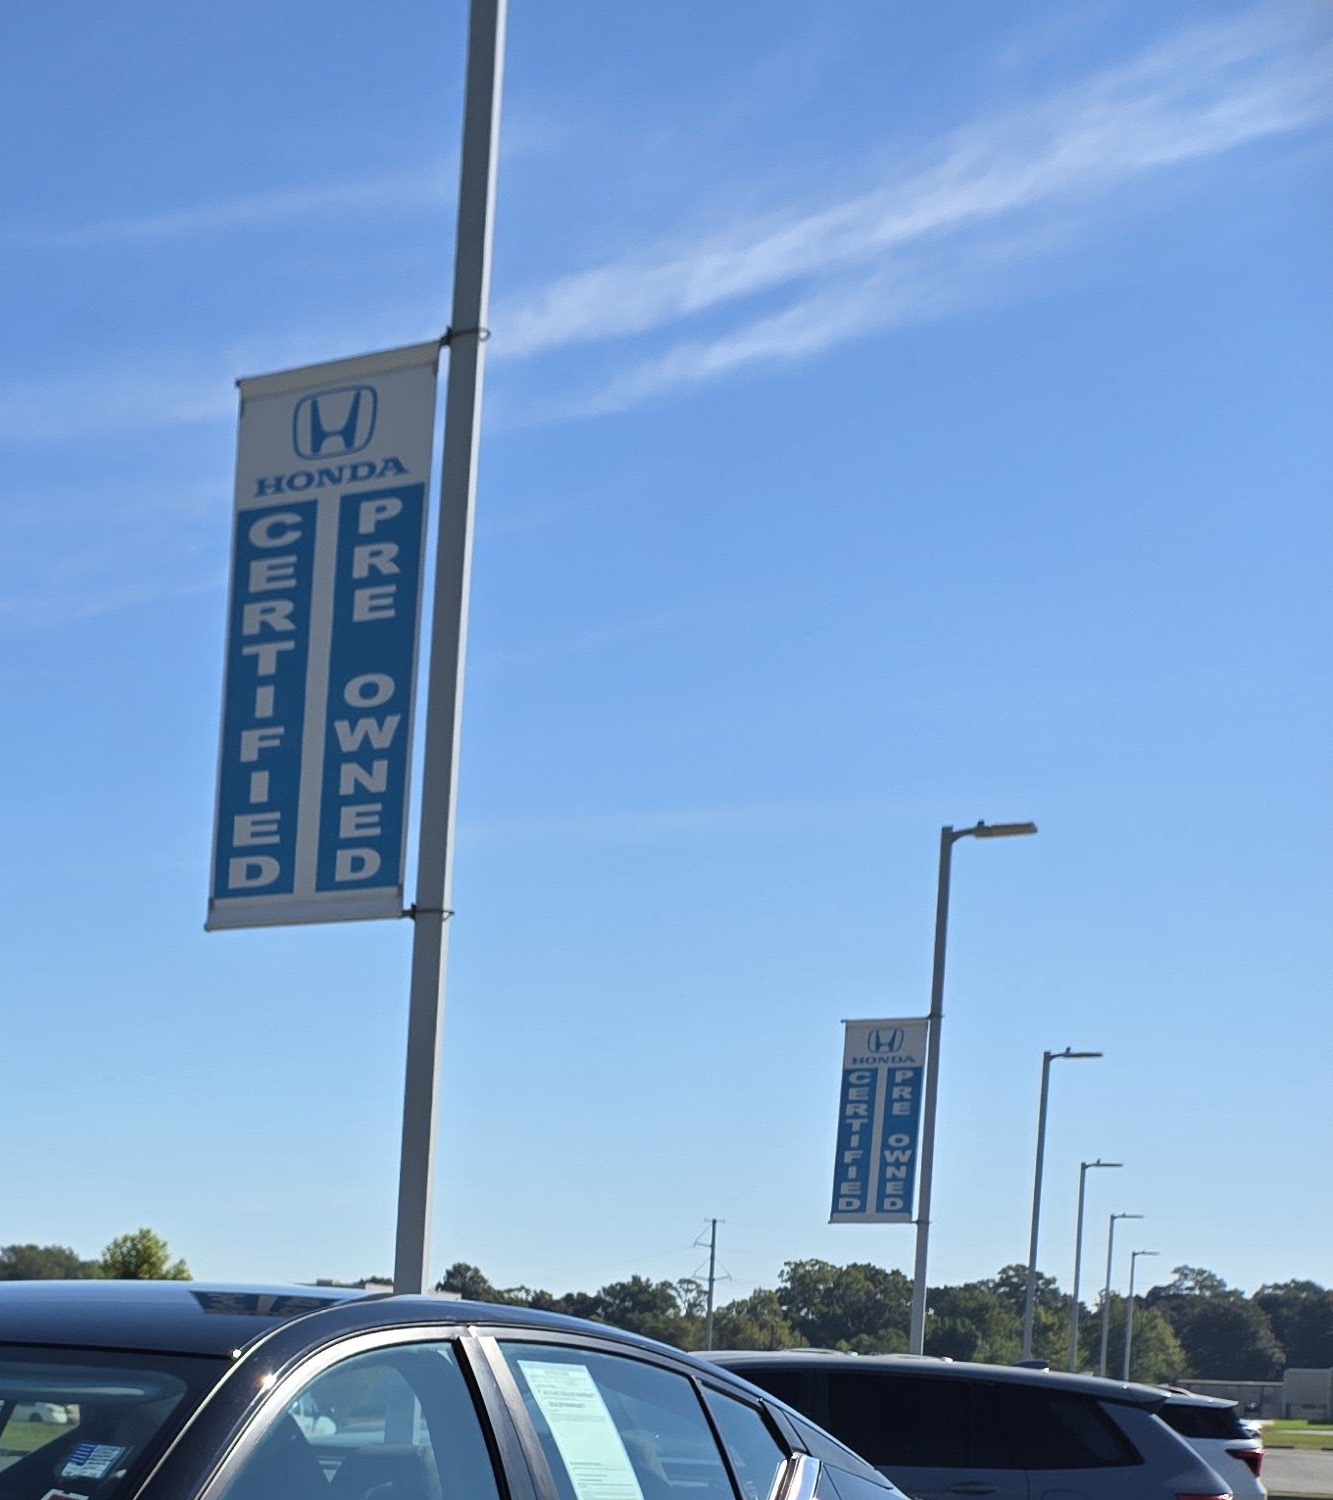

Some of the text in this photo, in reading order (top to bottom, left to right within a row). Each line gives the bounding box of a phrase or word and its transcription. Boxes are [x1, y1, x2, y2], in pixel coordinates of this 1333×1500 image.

[253, 455, 410, 498] HONDA
[227, 511, 304, 890] CERTIFIED
[334, 497, 404, 884] PRE OWNED
[851, 1054, 916, 1065] HONDA
[838, 1069, 872, 1211] CERTIFIED
[883, 1069, 914, 1211] PRE OWNED
